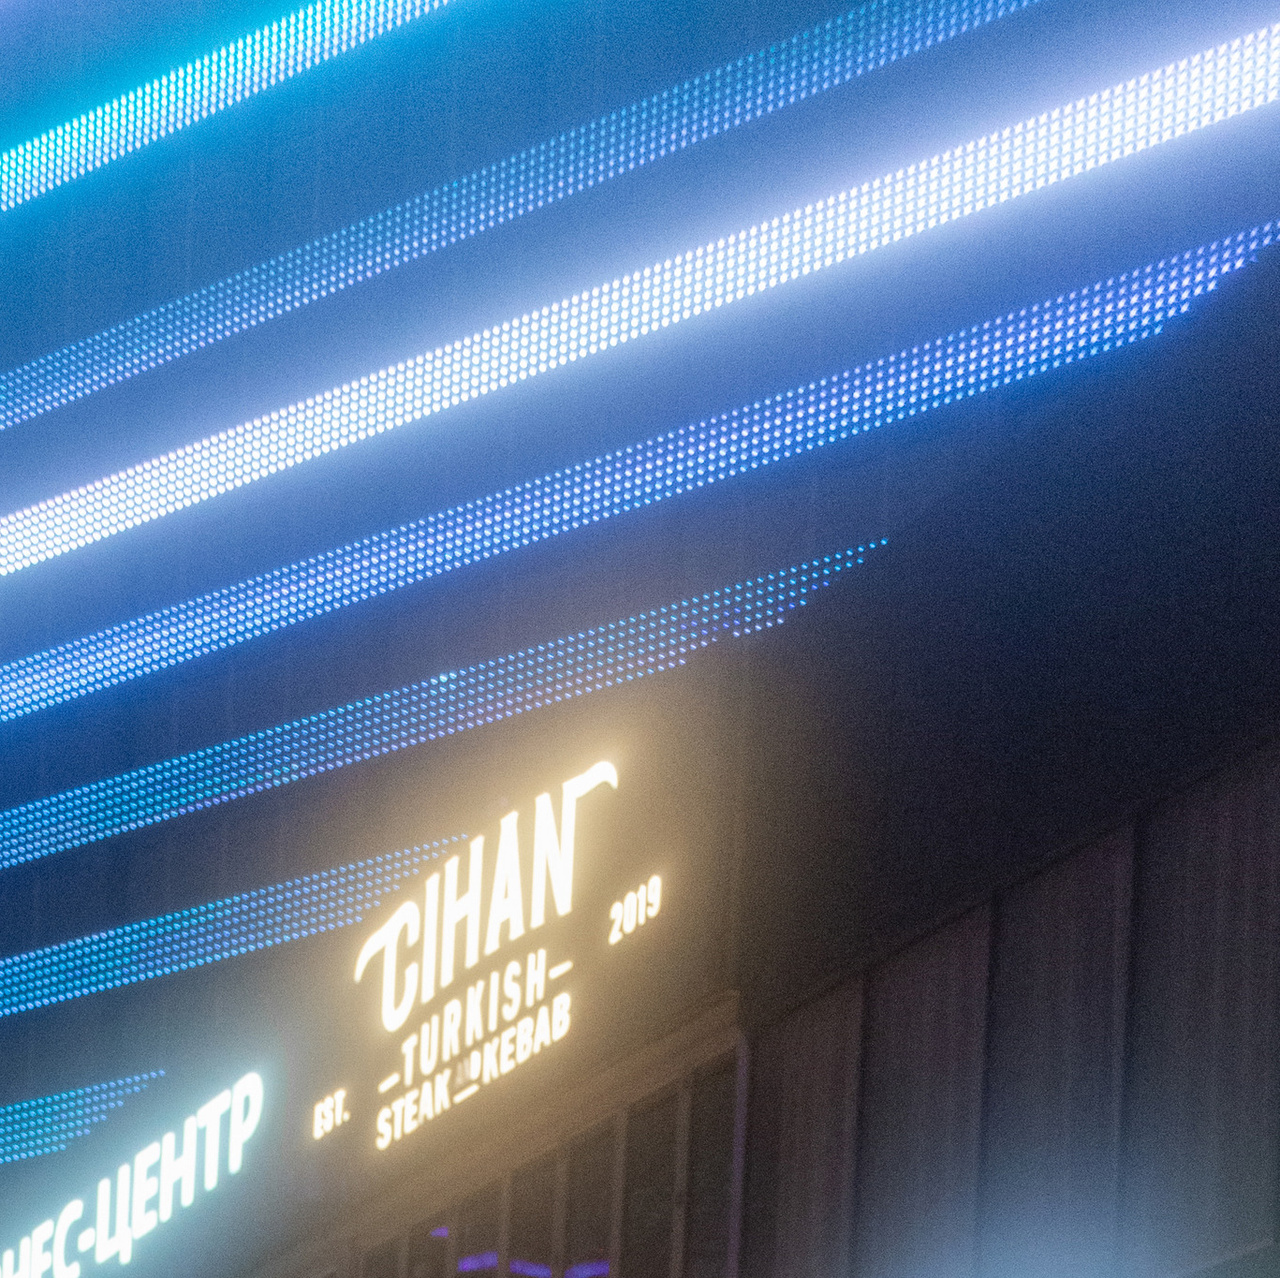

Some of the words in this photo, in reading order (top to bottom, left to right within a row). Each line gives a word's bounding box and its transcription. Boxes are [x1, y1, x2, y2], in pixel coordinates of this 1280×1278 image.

[354, 760, 618, 1033] CIHAN
[608, 874, 663, 946] 2019
[312, 1088, 351, 1141] EST.
[375, 1068, 453, 1151] STEAK
[482, 992, 573, 1086] KEBAB
